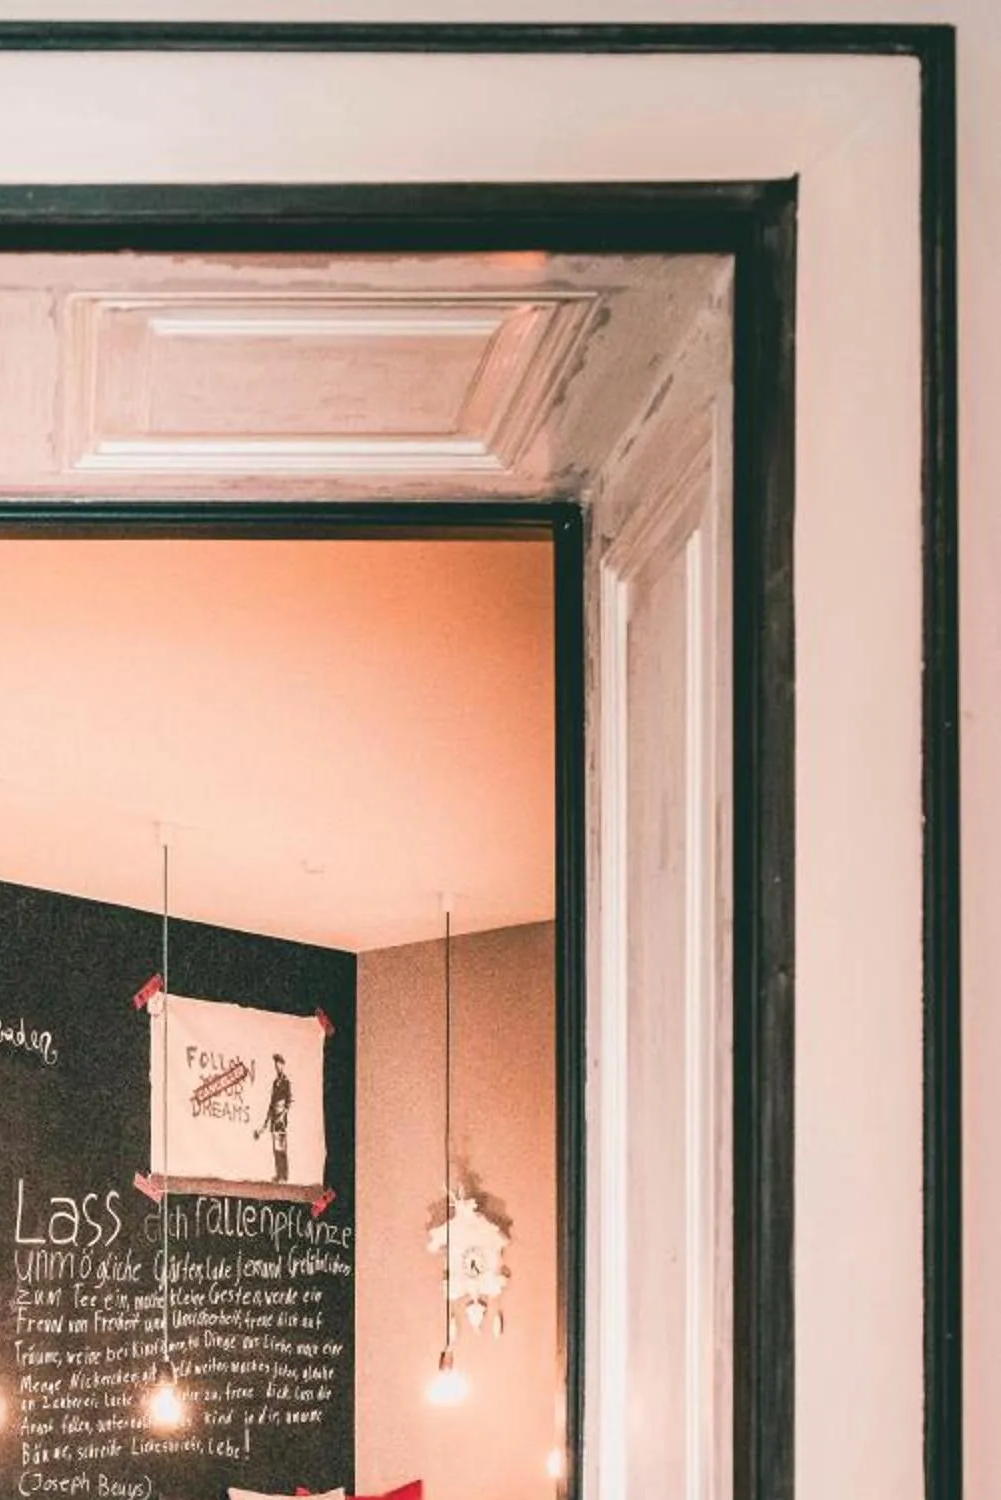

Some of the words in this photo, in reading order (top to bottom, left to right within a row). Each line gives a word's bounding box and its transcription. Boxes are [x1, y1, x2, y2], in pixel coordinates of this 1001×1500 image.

[192, 1098, 250, 1123] DREAMS
[15, 1178, 122, 1247] Lass
[143, 1204, 188, 1244] dch
[73, 1282, 98, 1309] Tee
[18, 1471, 91, 1498] (Joseph
